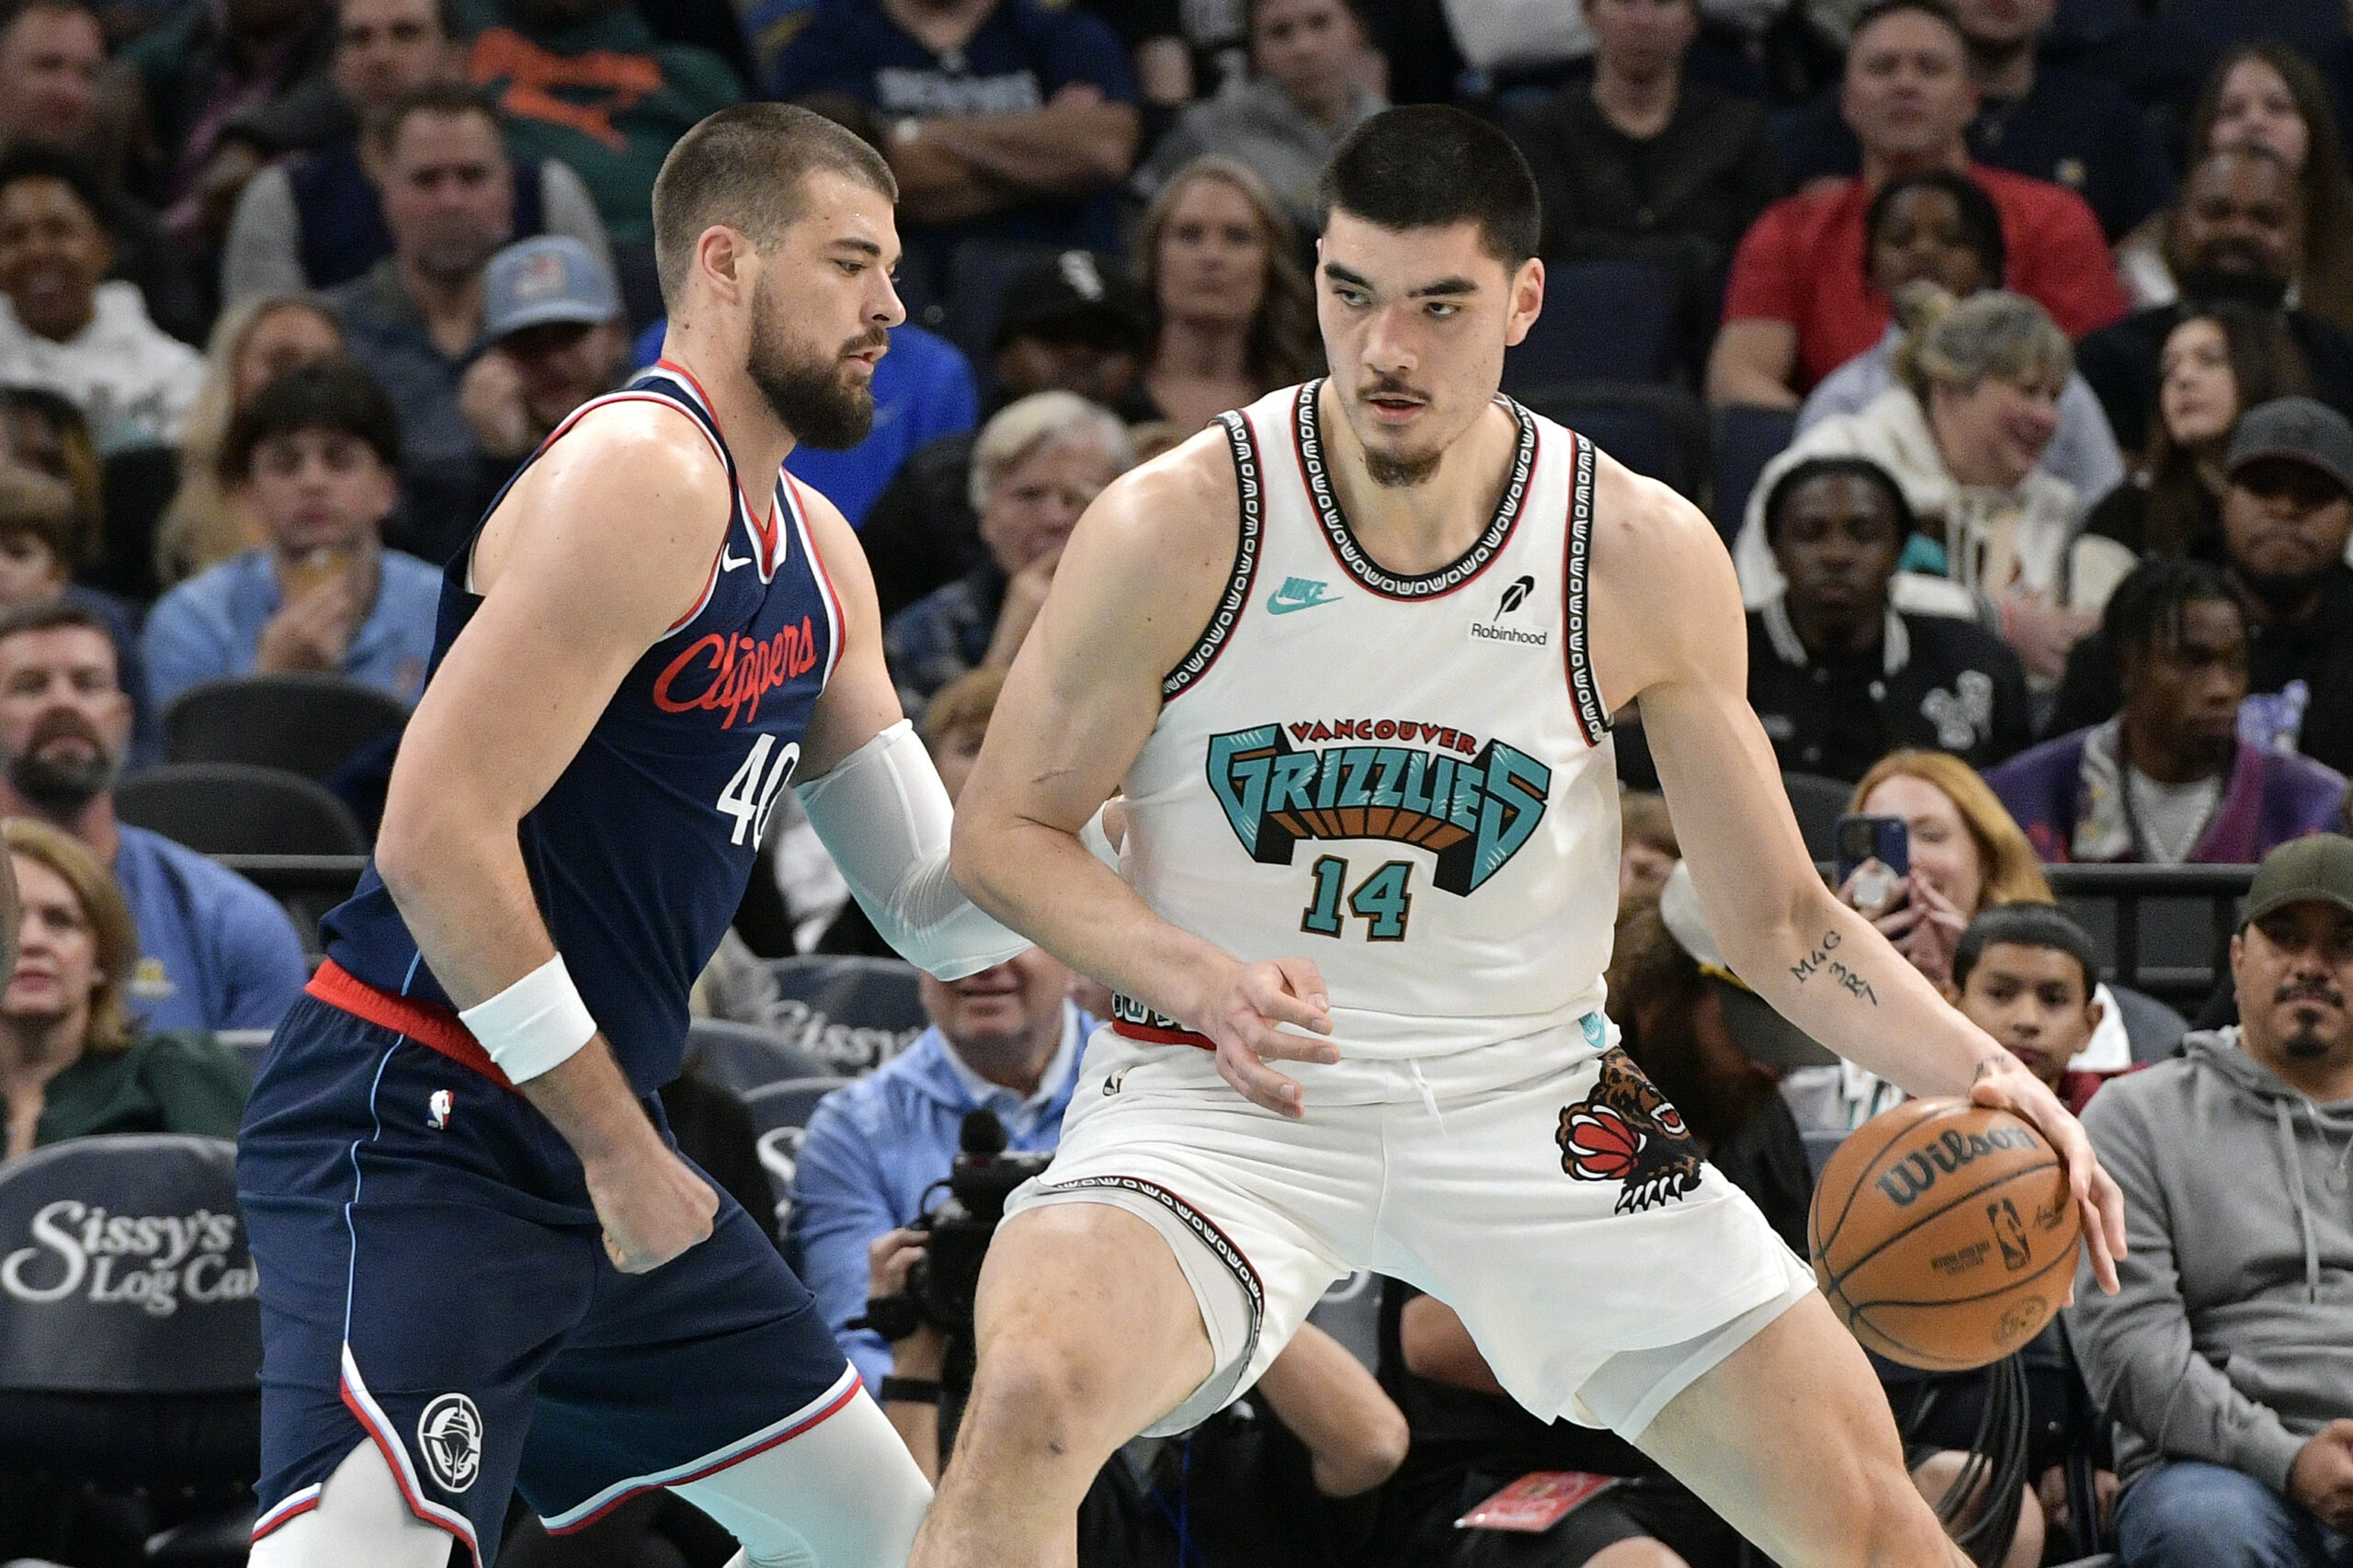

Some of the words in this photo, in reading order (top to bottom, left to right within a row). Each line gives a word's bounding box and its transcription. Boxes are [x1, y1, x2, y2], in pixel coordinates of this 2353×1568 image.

[653, 615, 818, 730] Clippers
[1471, 622, 1548, 646] Robinhood
[1289, 718, 1477, 756] VANCOUVER
[716, 733, 801, 853] 40
[1206, 722, 1552, 897] GRIZZLIES
[1300, 853, 1415, 943] 14
[1789, 929, 1842, 983] M4G
[1874, 1127, 2040, 1207] Wilson
[1, 1199, 237, 1302] Sissy's
[88, 1255, 178, 1316] Log
